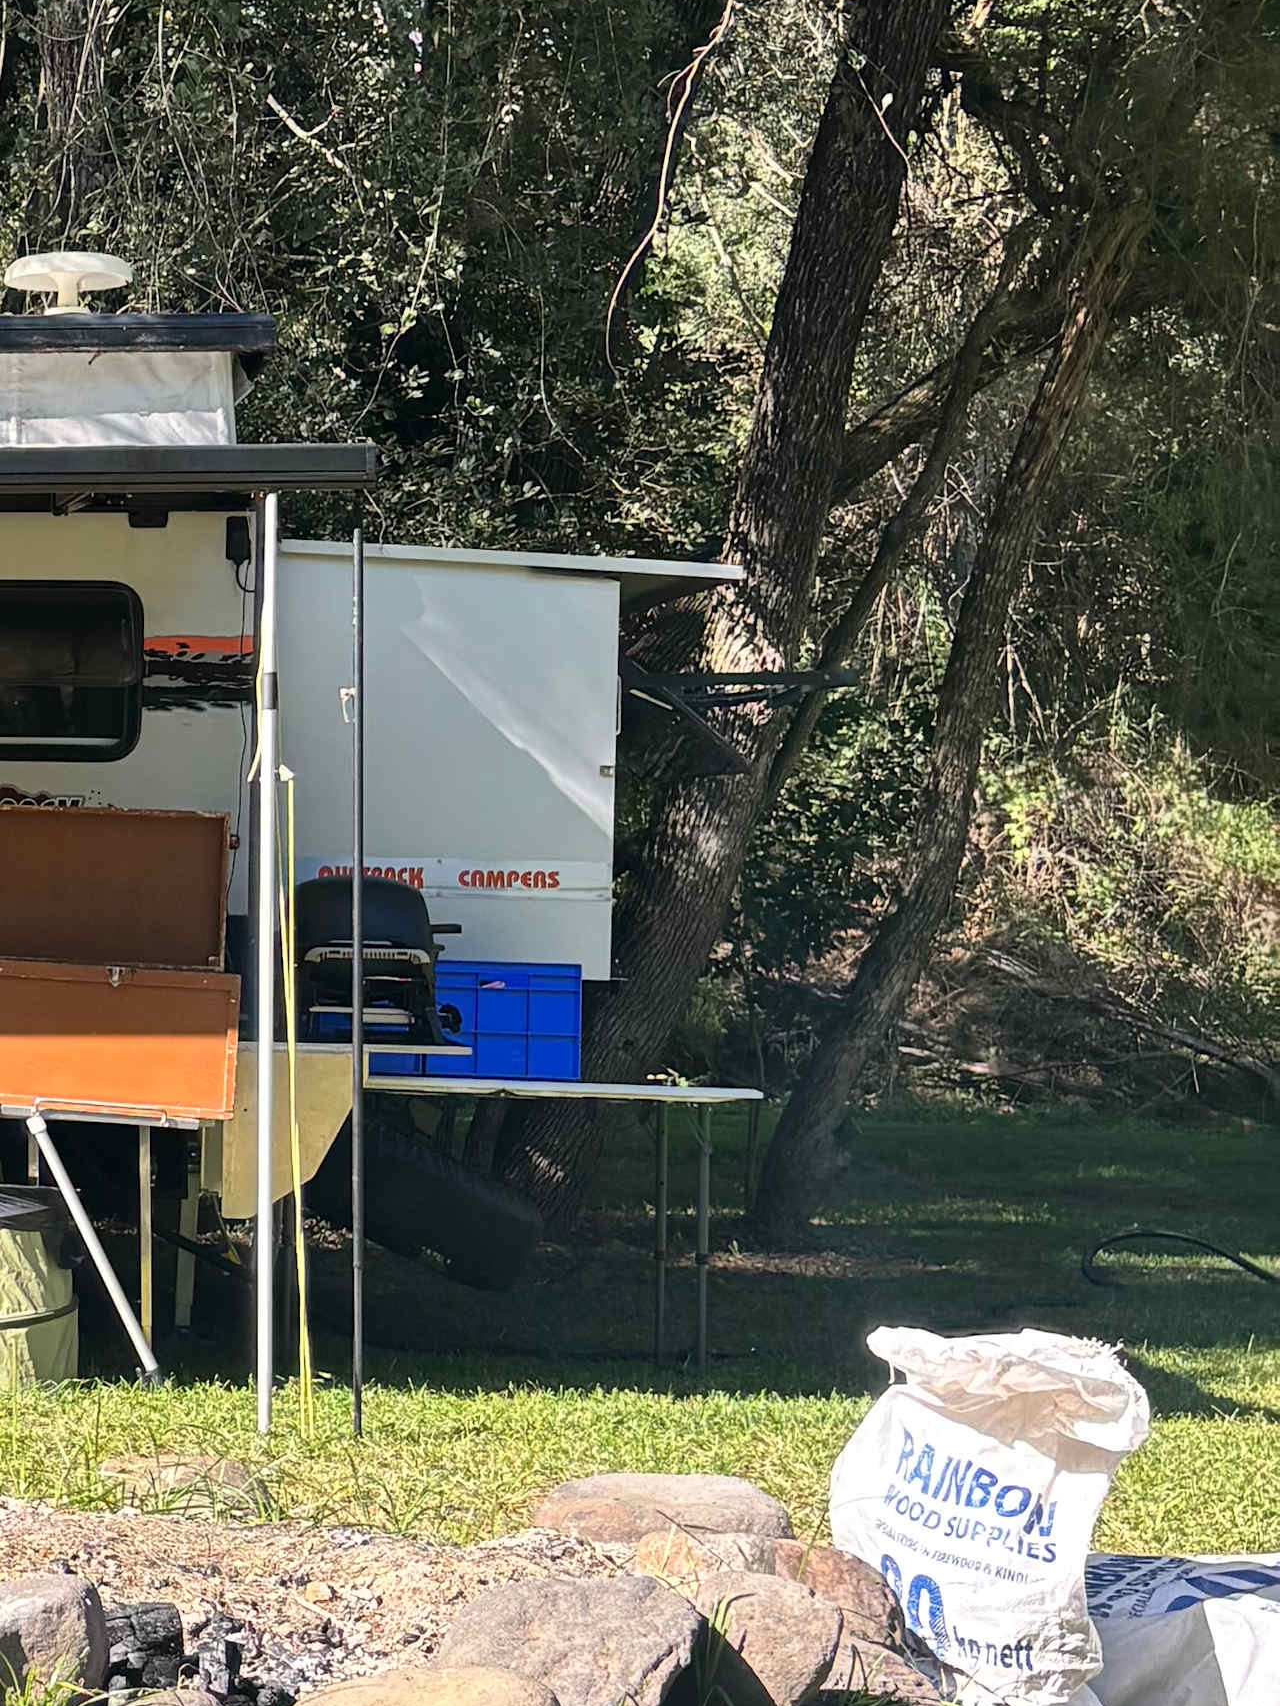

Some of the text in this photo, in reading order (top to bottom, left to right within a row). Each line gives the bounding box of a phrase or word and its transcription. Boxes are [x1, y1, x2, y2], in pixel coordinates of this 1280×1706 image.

[457, 869, 561, 890] CAMPERS
[943, 1515, 1058, 1563] SUPPLIES
[985, 1638, 1034, 1672] nett
